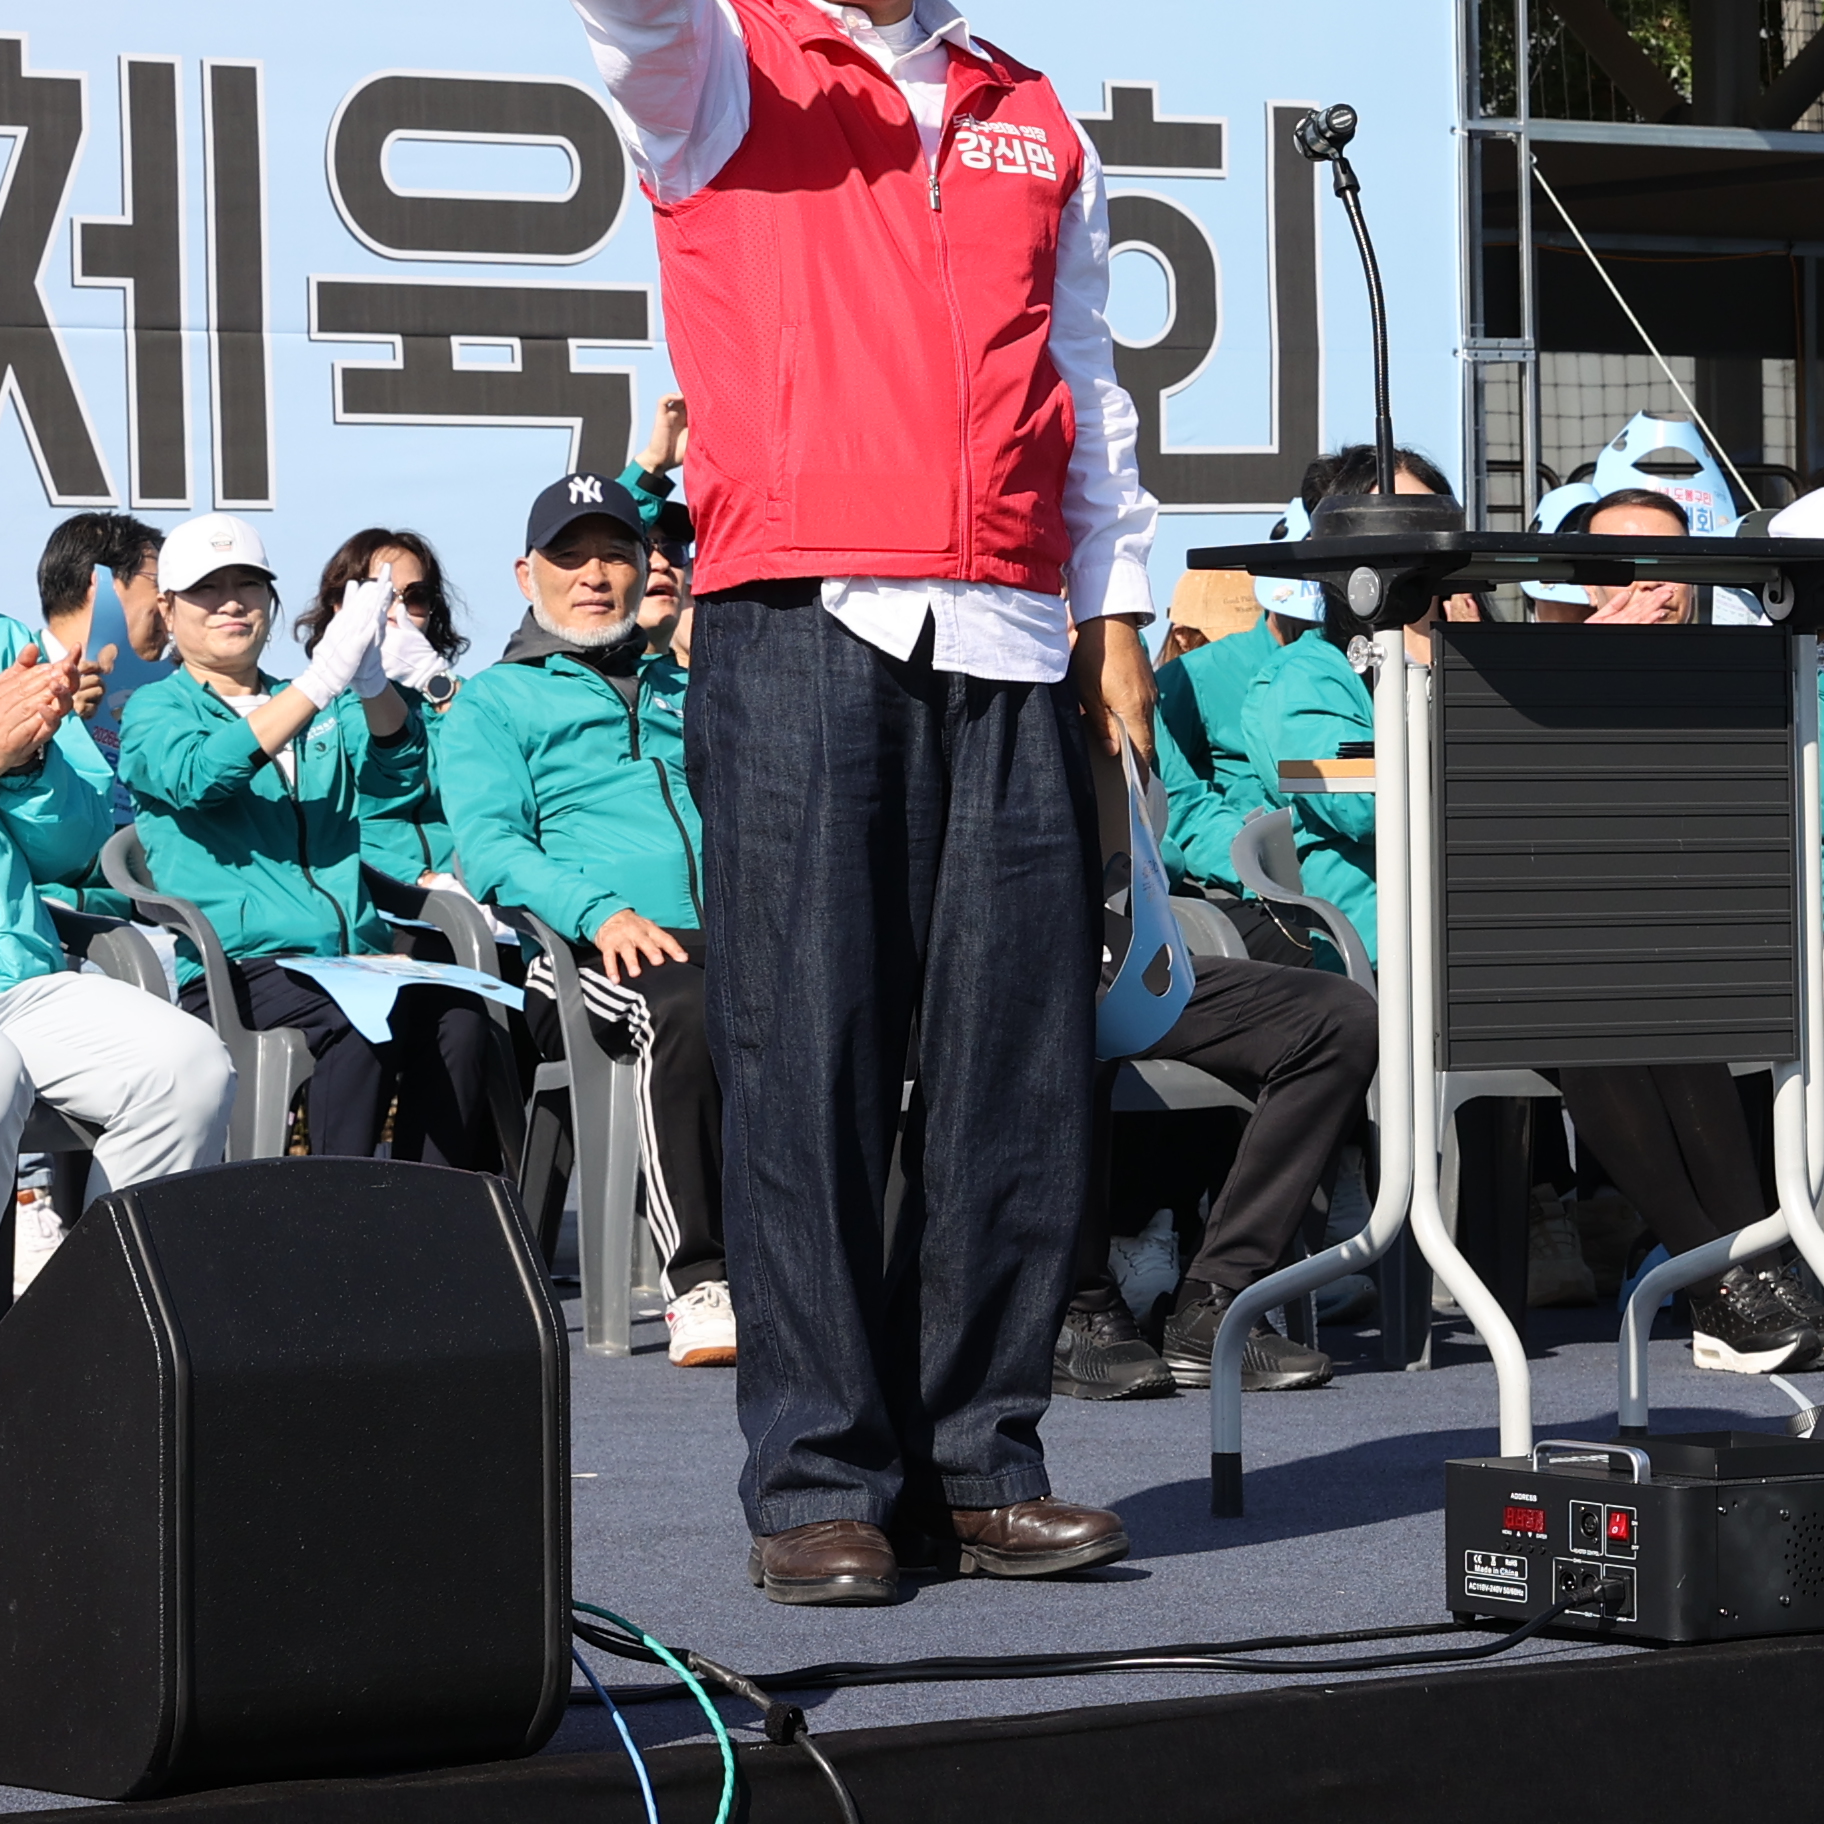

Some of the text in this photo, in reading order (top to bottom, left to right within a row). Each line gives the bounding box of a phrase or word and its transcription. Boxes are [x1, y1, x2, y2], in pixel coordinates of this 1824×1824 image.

[955, 131, 1058, 181] 강신만
[1474, 1564, 1519, 1578] Made in China
